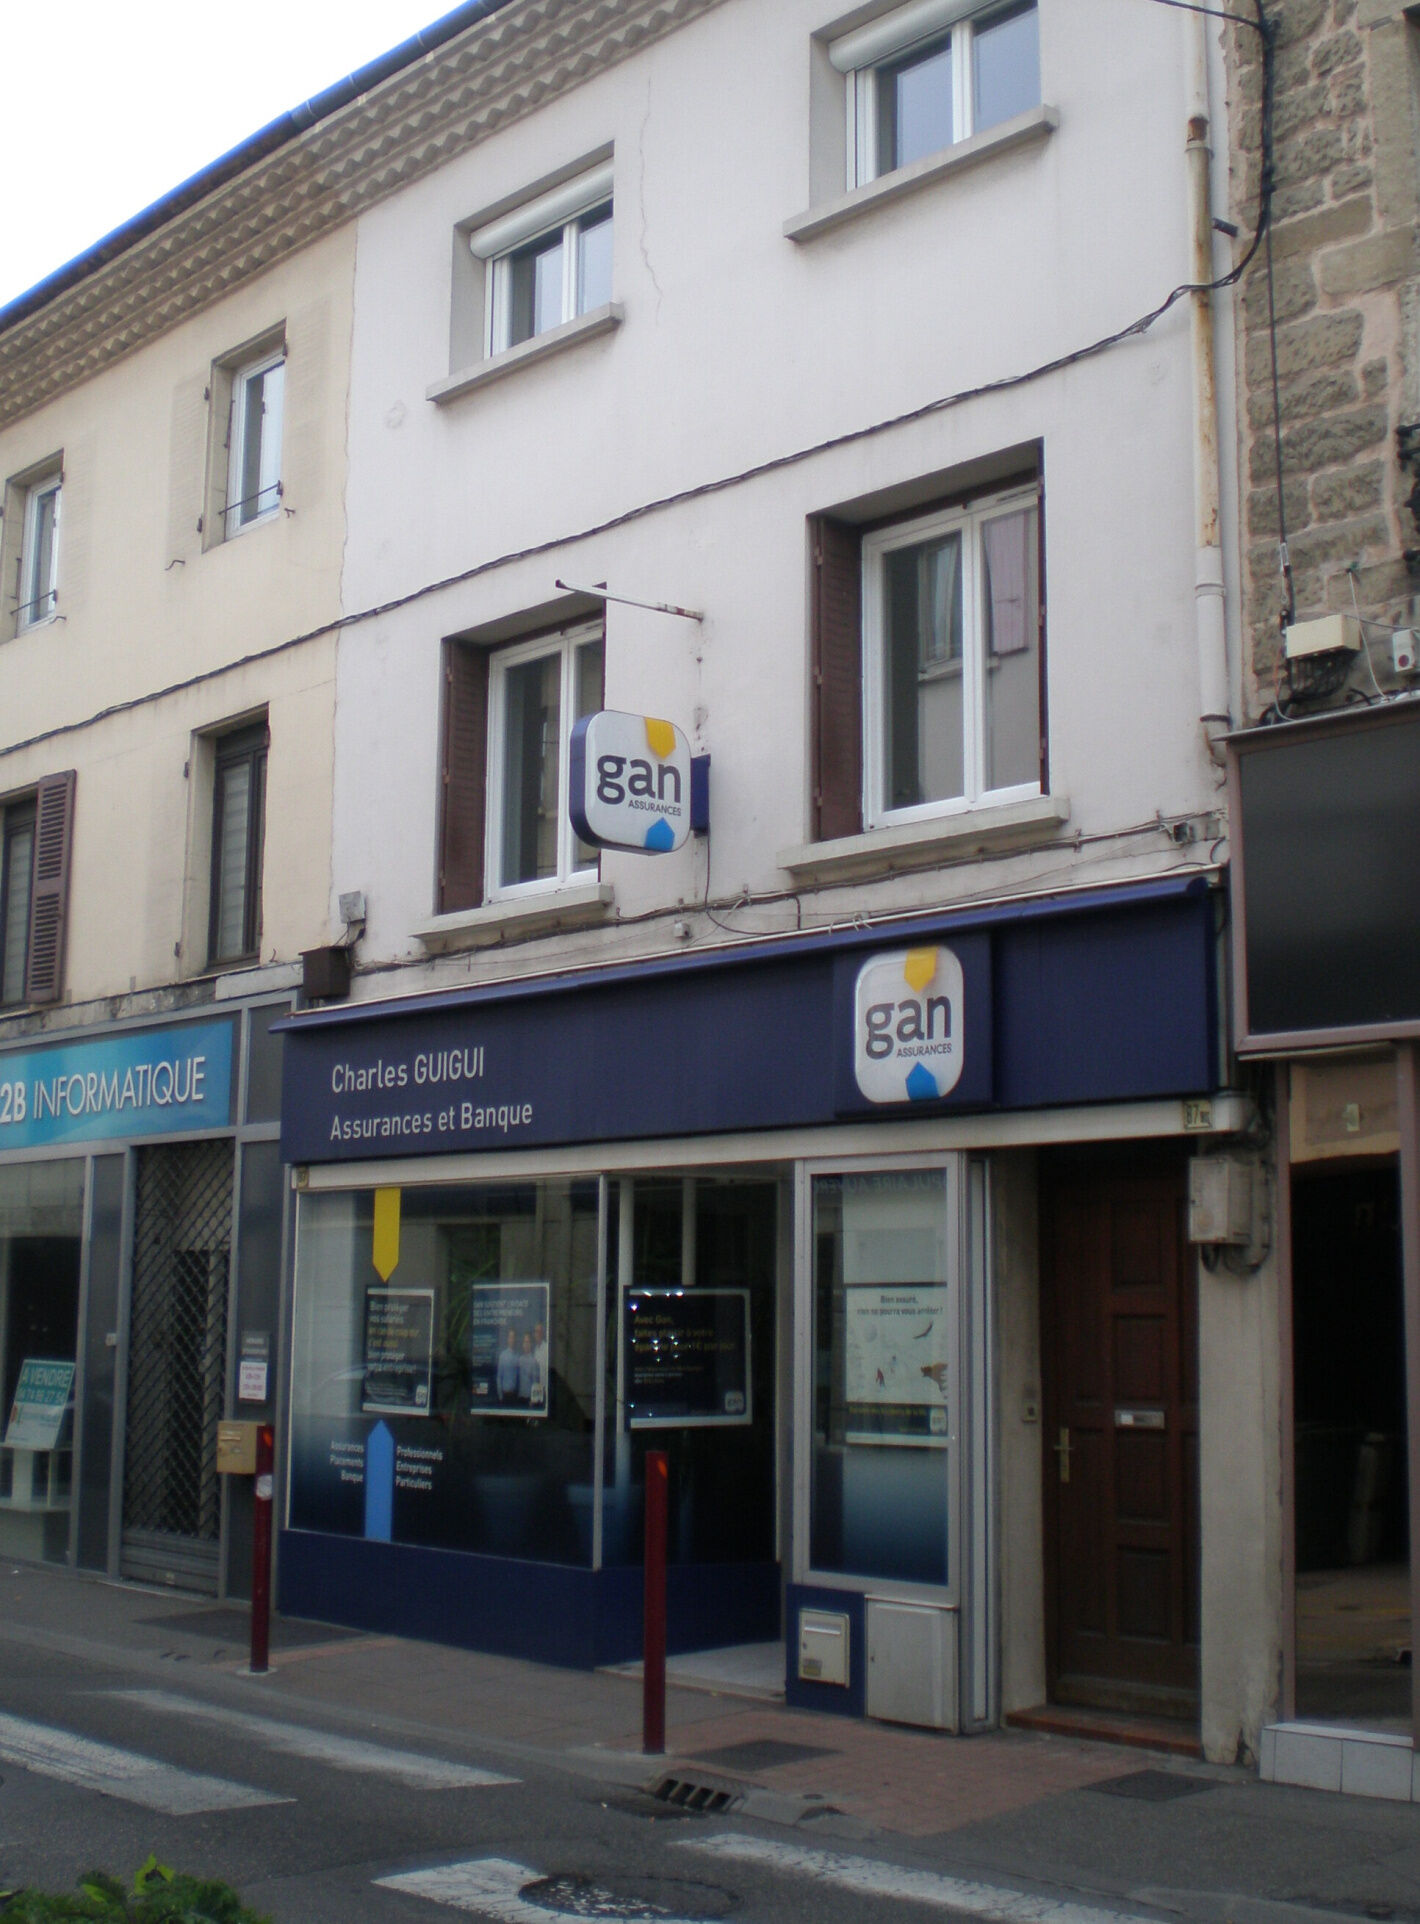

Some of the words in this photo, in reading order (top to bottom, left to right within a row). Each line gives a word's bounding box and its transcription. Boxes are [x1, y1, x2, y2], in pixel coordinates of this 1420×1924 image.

[597, 755, 681, 805] gan
[628, 799, 682, 817] ASSURANCES
[865, 996, 951, 1059] gan
[332, 1059, 408, 1093] Charles
[414, 1047, 484, 1084] GUIGUI
[896, 1043, 952, 1058] ASSURANCES
[33, 1056, 206, 1119] INFORMATIQUE
[330, 1114, 432, 1141] Assurances
[438, 1106, 455, 1131] et
[461, 1102, 533, 1133] Banque
[30, 1366, 71, 1388] VENDRE
[341, 1469, 364, 1483] Banque
